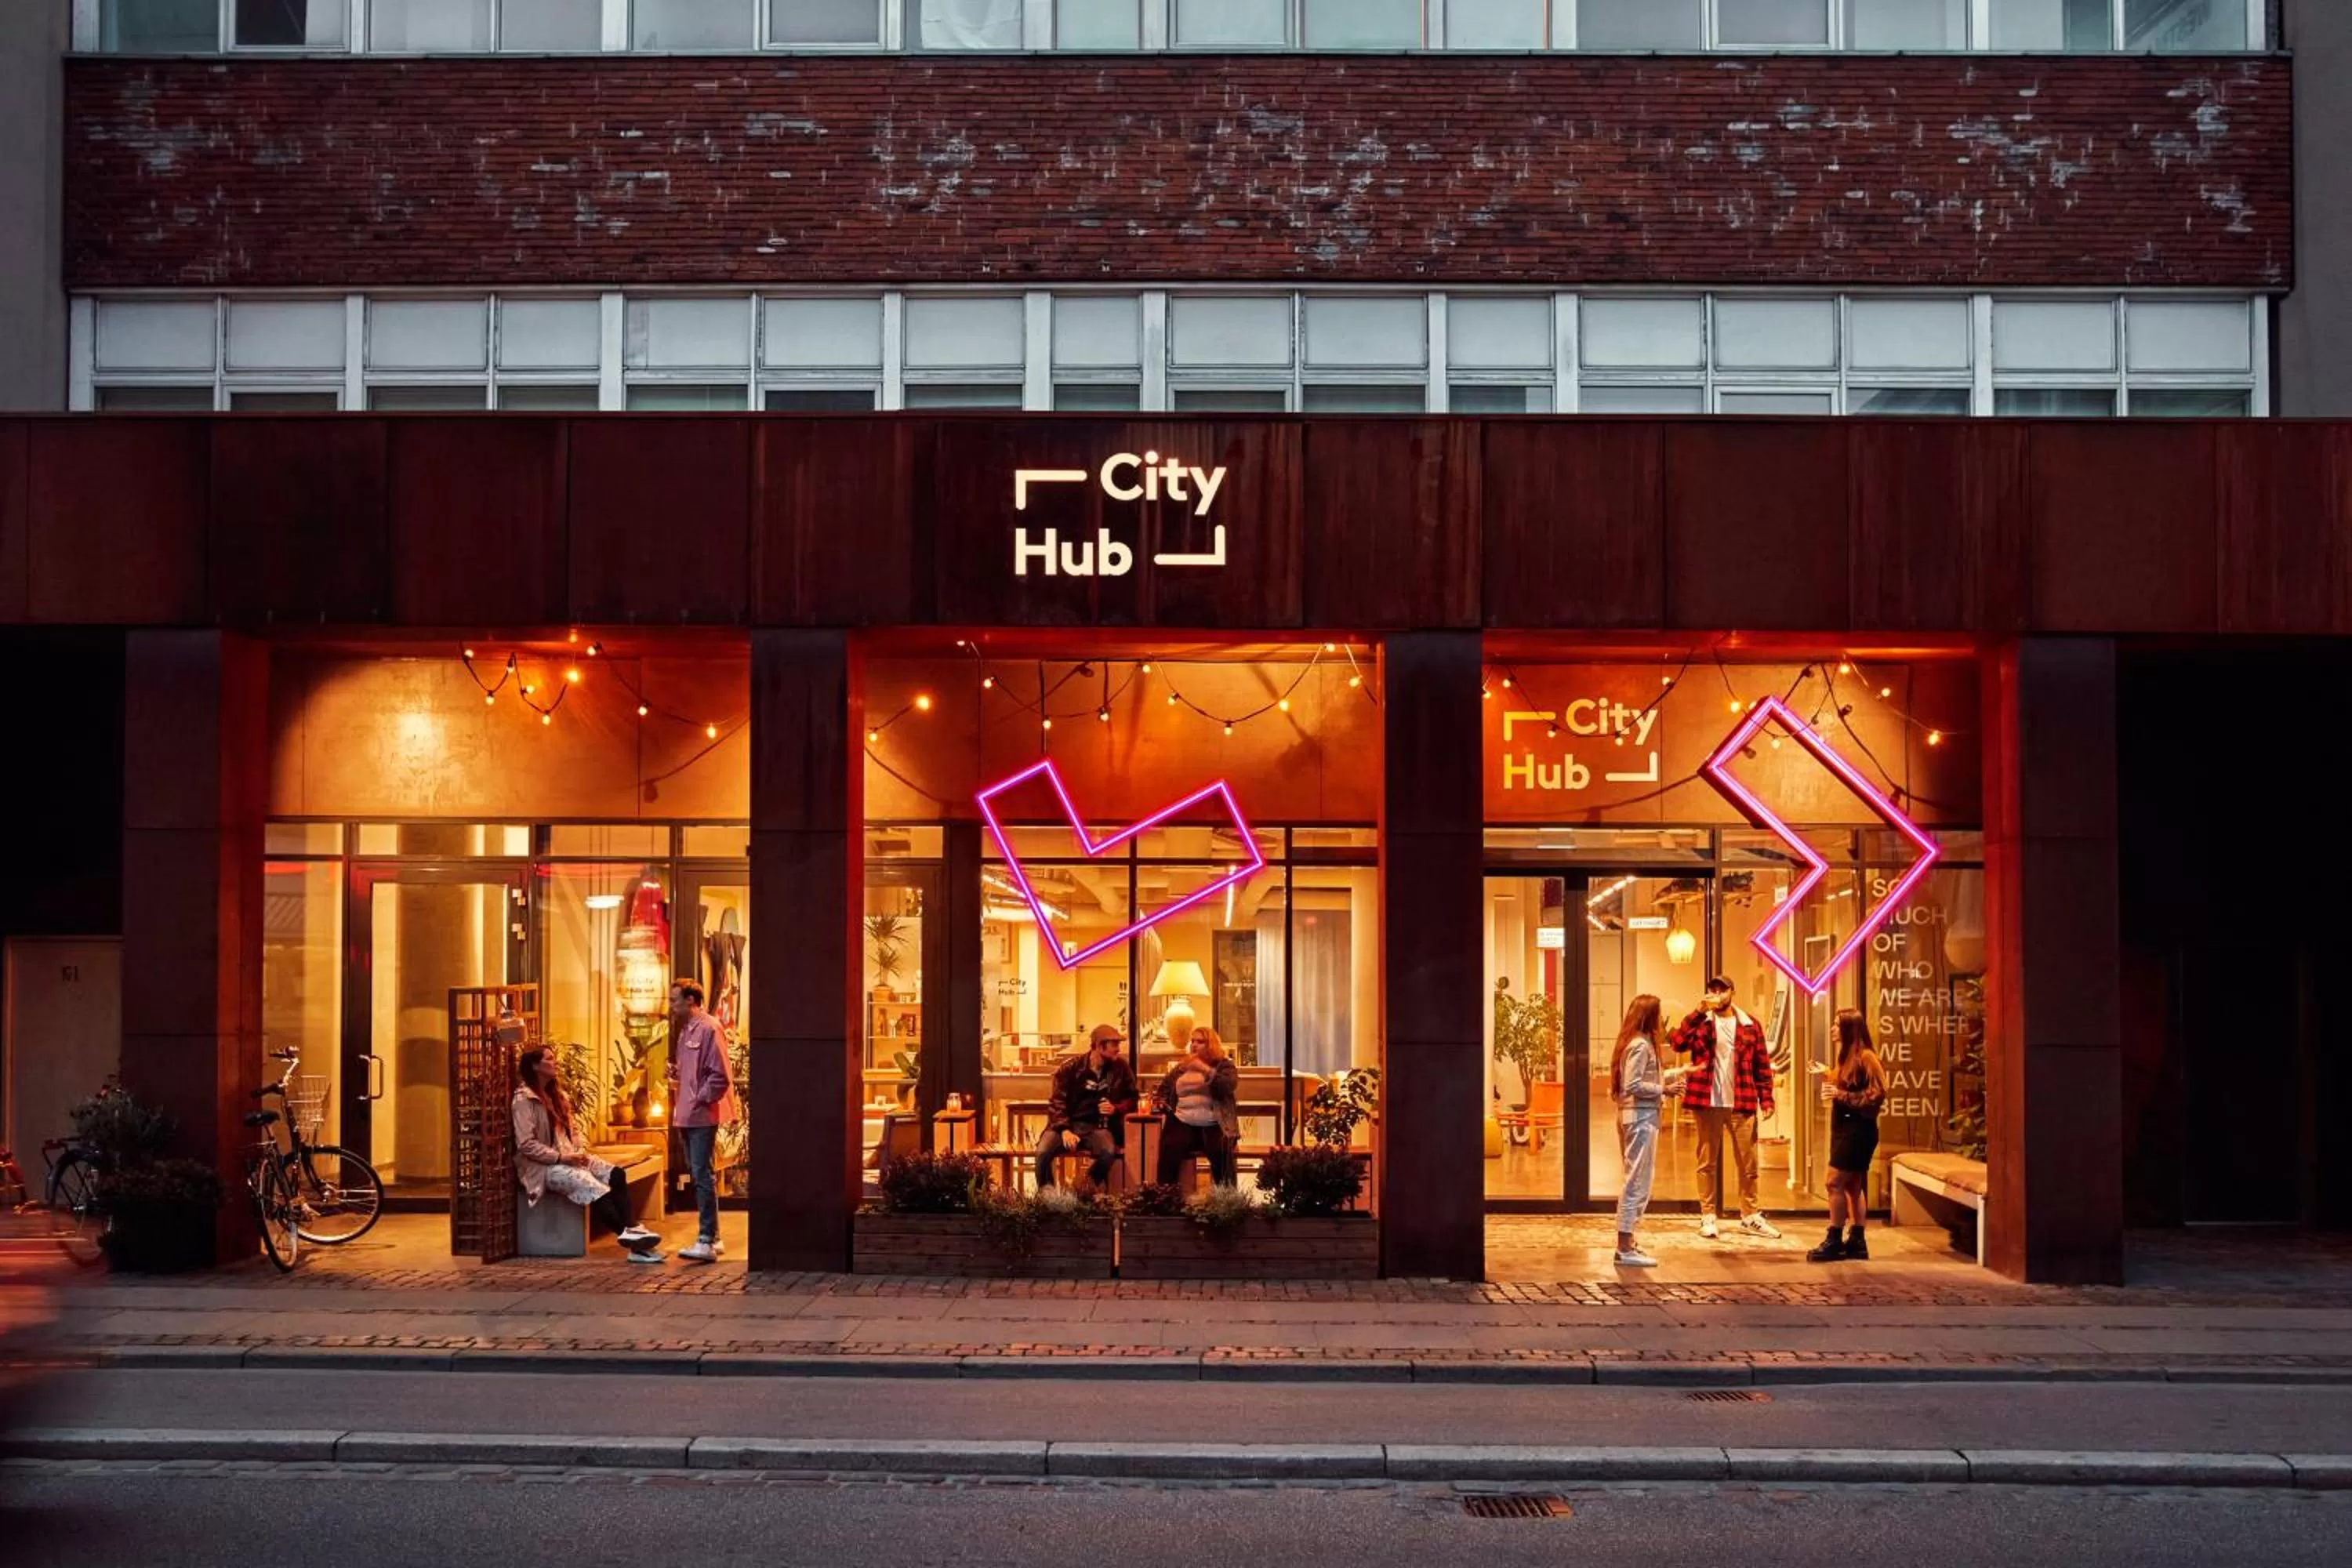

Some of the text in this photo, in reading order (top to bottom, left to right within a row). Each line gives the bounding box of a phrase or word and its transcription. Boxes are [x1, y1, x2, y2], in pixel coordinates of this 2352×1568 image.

[1100, 450, 1227, 516] City
[1014, 527, 1134, 577] Hub
[1566, 697, 1658, 746] City
[1503, 753, 1591, 790] Hub
[1887, 906, 1948, 926] UCH
[1871, 933, 1907, 953] OF
[1872, 960, 1933, 980] WHO
[1917, 988, 1965, 1007] ARE
[1900, 1015, 1969, 1035] WHER
